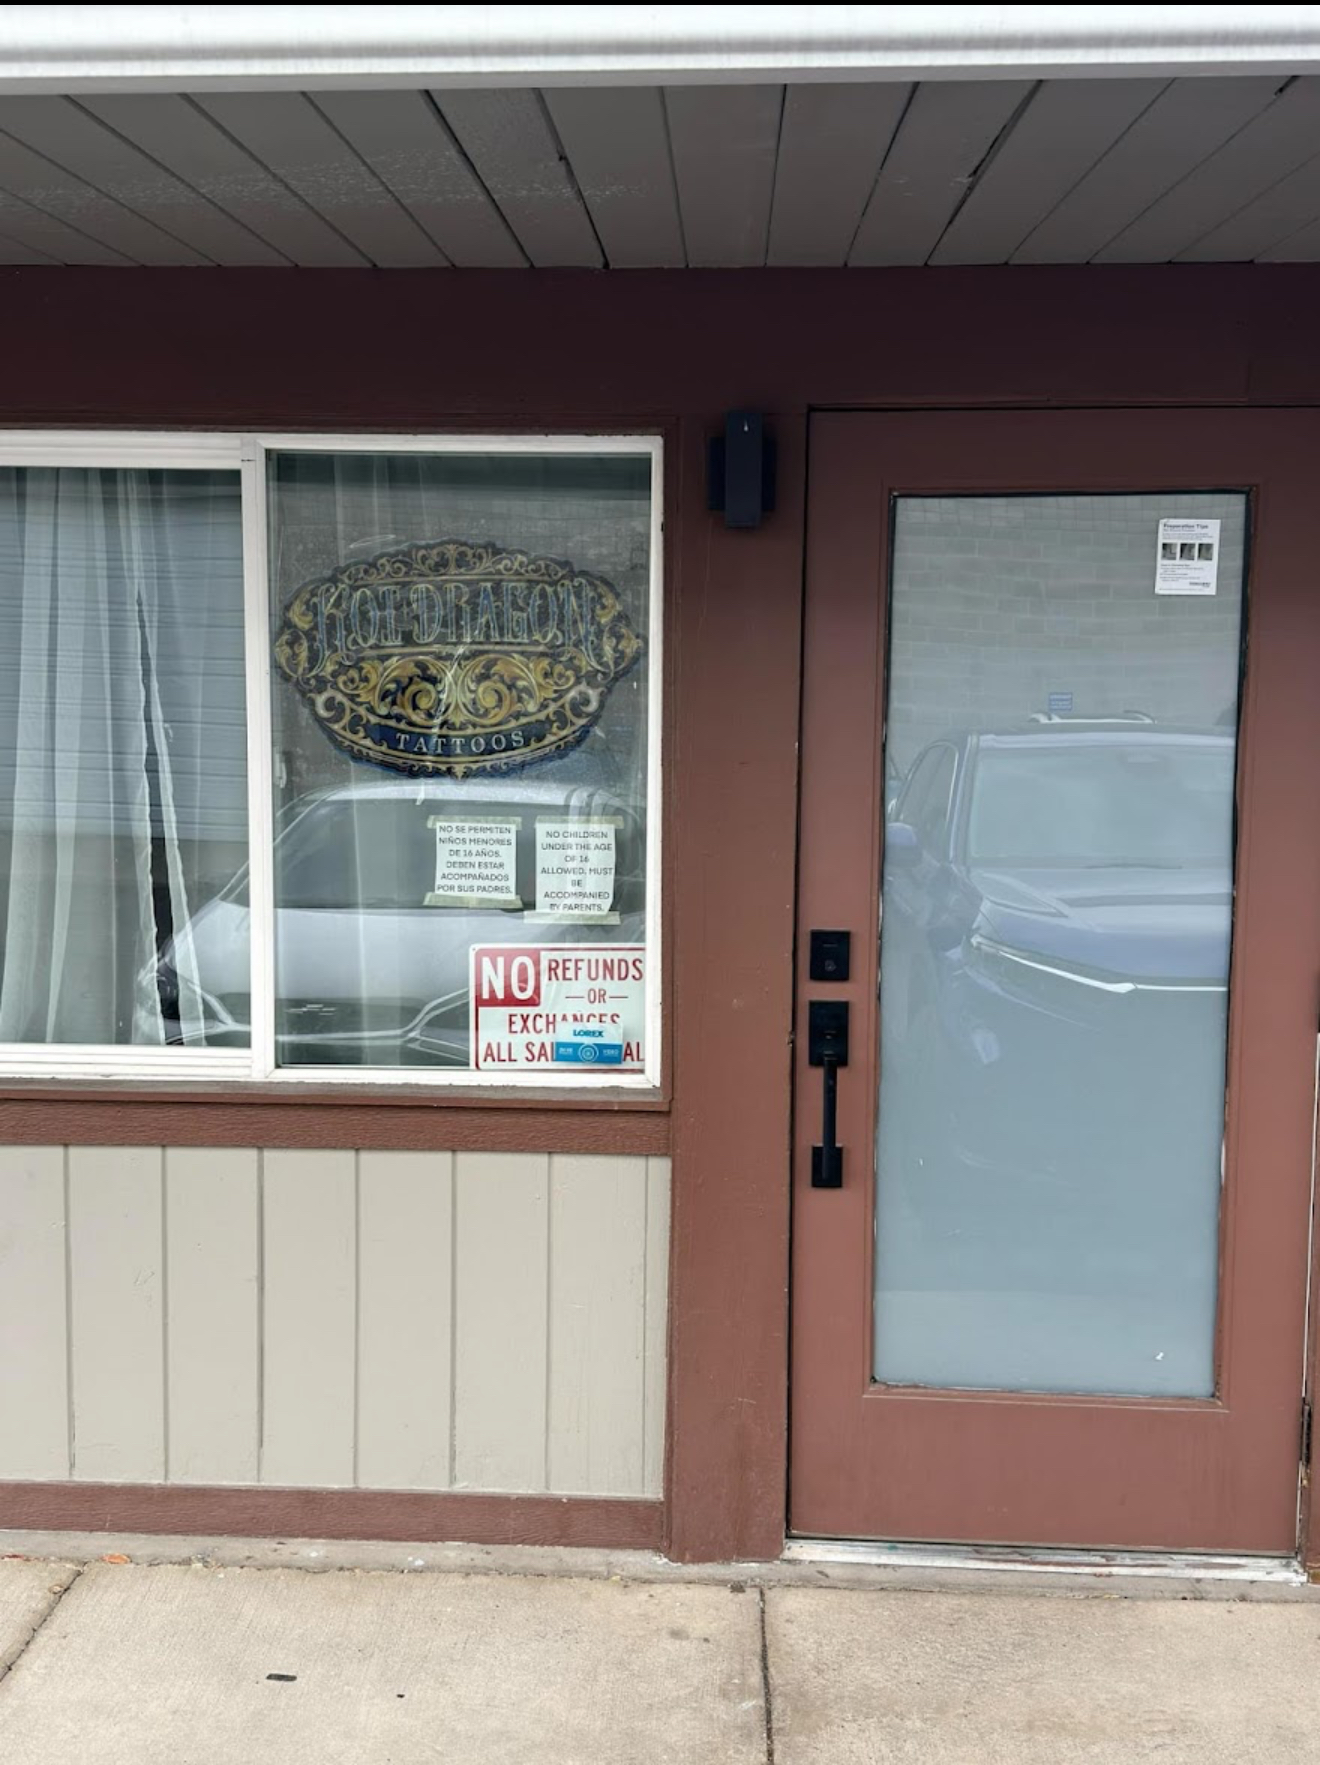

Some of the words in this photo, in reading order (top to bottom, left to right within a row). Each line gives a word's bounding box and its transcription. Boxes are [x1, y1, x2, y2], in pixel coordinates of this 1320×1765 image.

[306, 582, 404, 676] KOI
[409, 578, 612, 674] DRAGON
[395, 732, 525, 755] TATTOOS
[439, 825, 453, 833] NO
[455, 825, 466, 834] SE
[468, 826, 511, 834] PERMITEN
[562, 831, 608, 839] CHILDREN
[439, 836, 467, 845] NIÑOS
[469, 838, 512, 846] MENORES
[541, 843, 573, 851] UNDER
[575, 843, 592, 851] THE
[594, 843, 612, 851] AGE
[448, 849, 461, 857] DE
[463, 849, 473, 858] 16
[564, 855, 576, 863] OF
[579, 855, 590, 863] 16
[446, 861, 475, 869] DEBEN
[478, 861, 504, 870] ESTAR
[589, 867, 613, 875] MUST
[441, 872, 509, 881] ACOMPAÑADOS
[437, 884, 455, 892] POR
[457, 885, 475, 893] SUS
[477, 885, 513, 894] PADRES.
[544, 891, 610, 899] ACCOMPANIED
[549, 903, 560, 911] BY
[563, 903, 605, 911] PARENTS.
[547, 958, 643, 981] REFUNDS
[481, 956, 535, 1000] NO
[587, 988, 607, 1004] OR
[573, 1029, 604, 1039] LOREX
[483, 1041, 517, 1063] ALL
